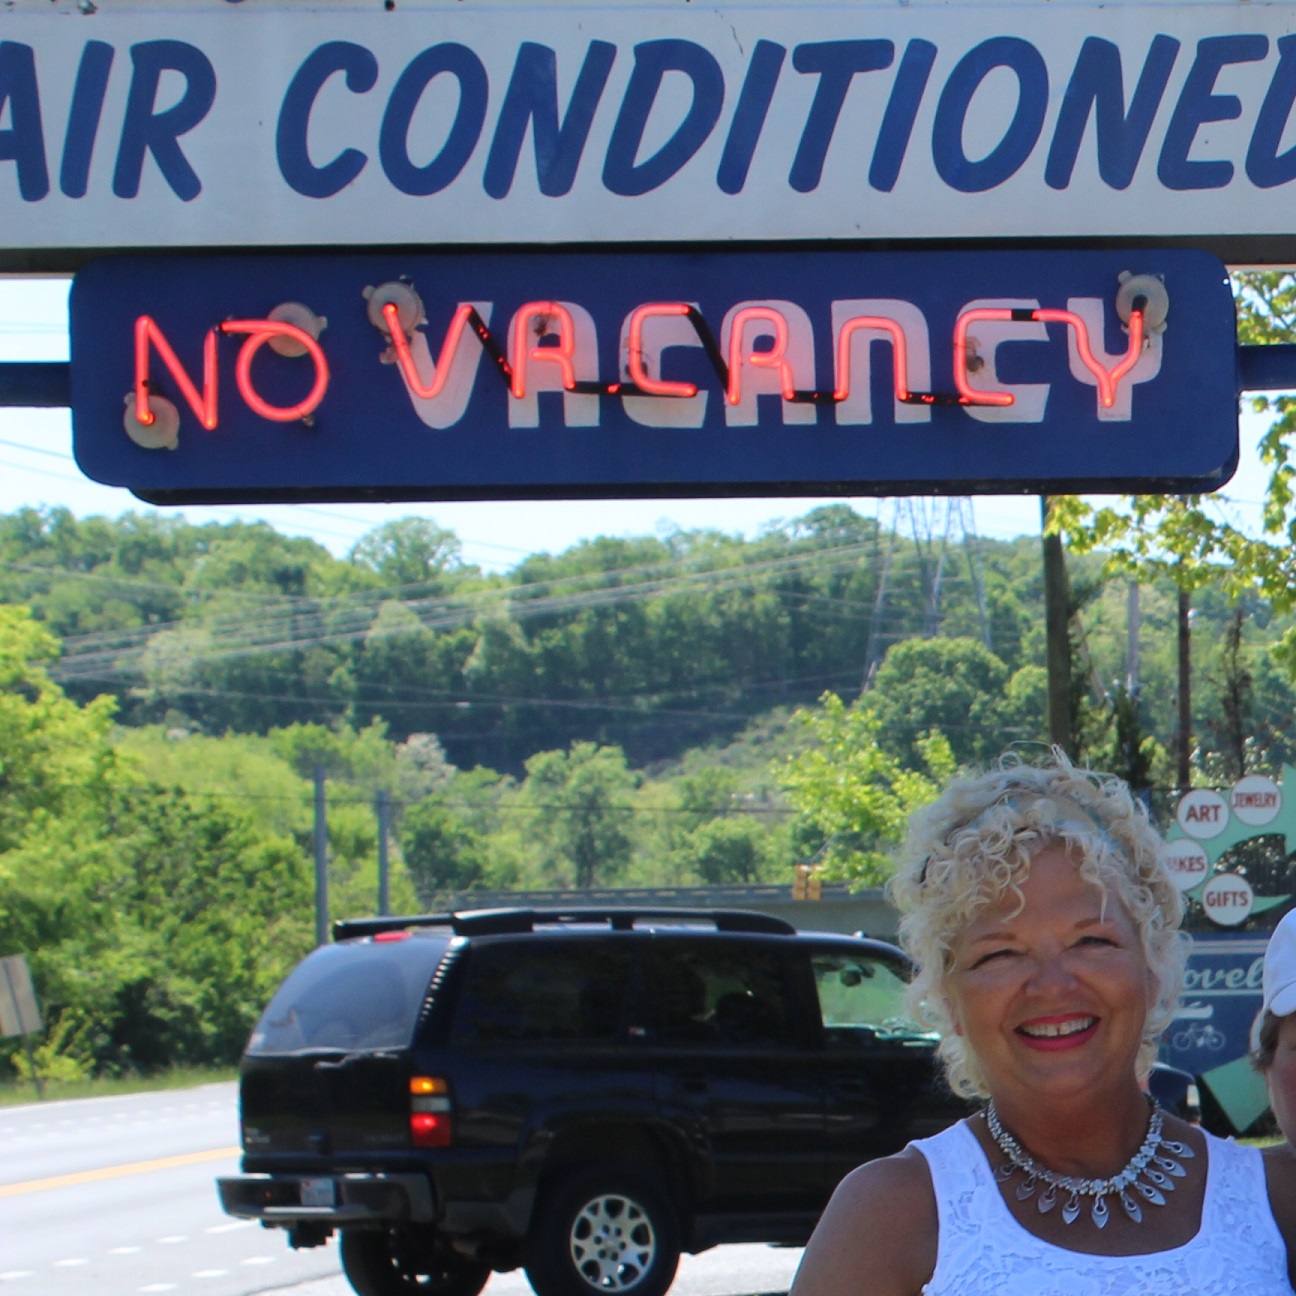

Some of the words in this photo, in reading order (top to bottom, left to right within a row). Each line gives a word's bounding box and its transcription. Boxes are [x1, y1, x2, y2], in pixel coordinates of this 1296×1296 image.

[0, 37, 217, 202] AIR
[134, 314, 329, 430] NO
[382, 298, 1164, 430] VACANCY
[1232, 791, 1277, 809] JEWELRY
[1185, 804, 1222, 823] ART
[1167, 855, 1206, 873] KES
[1205, 890, 1249, 908] GIFTS
